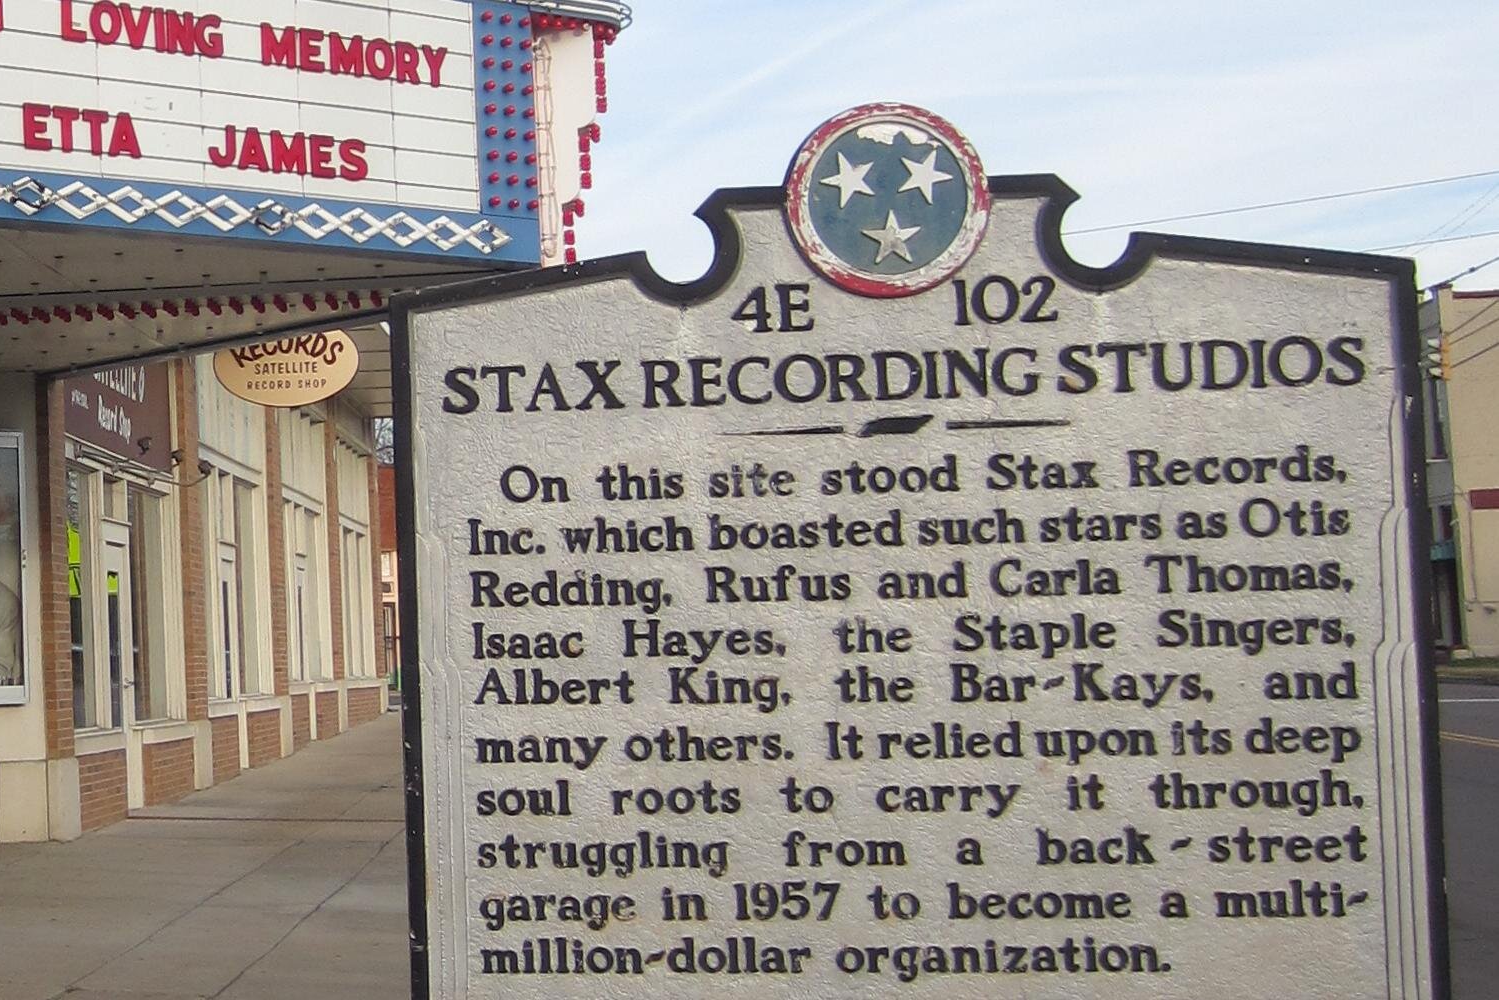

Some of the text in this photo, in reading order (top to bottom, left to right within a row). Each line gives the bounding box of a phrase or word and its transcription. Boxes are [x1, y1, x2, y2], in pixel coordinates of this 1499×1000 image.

[61, 0, 224, 58] LOVING
[260, 22, 448, 88] MEMORY
[23, 102, 368, 181] ETTA JAMES
[731, 275, 1058, 333] 4E 102
[247, 378, 327, 390] RECORD SHOP
[254, 361, 318, 376] SATELLITE
[442, 336, 1365, 415] STAX RECORDING STUDIOS
[500, 445, 1347, 503] On this site stood Stax Records,
[468, 498, 1350, 555] Inc. which boasted such stars as Otis
[469, 555, 1354, 614] Redding, Rufus and Carla Thomas,
[472, 610, 1355, 664] Isaac Hayes, the Staple Singers,
[474, 661, 1359, 713] Albert King, the Bar-Kays, and
[474, 717, 1361, 770] many others. It relied upon its deep
[477, 769, 1363, 818] soul roots to carry it through,
[478, 831, 729, 878] struggling
[782, 831, 907, 867] from
[956, 838, 984, 865] a
[479, 895, 635, 931] garage
[662, 887, 708, 921] in
[734, 881, 840, 921] 1957
[867, 886, 920, 920] to
[946, 883, 1131, 919] become
[1159, 892, 1189, 918] a
[481, 937, 1171, 982] million-dollar organization.
